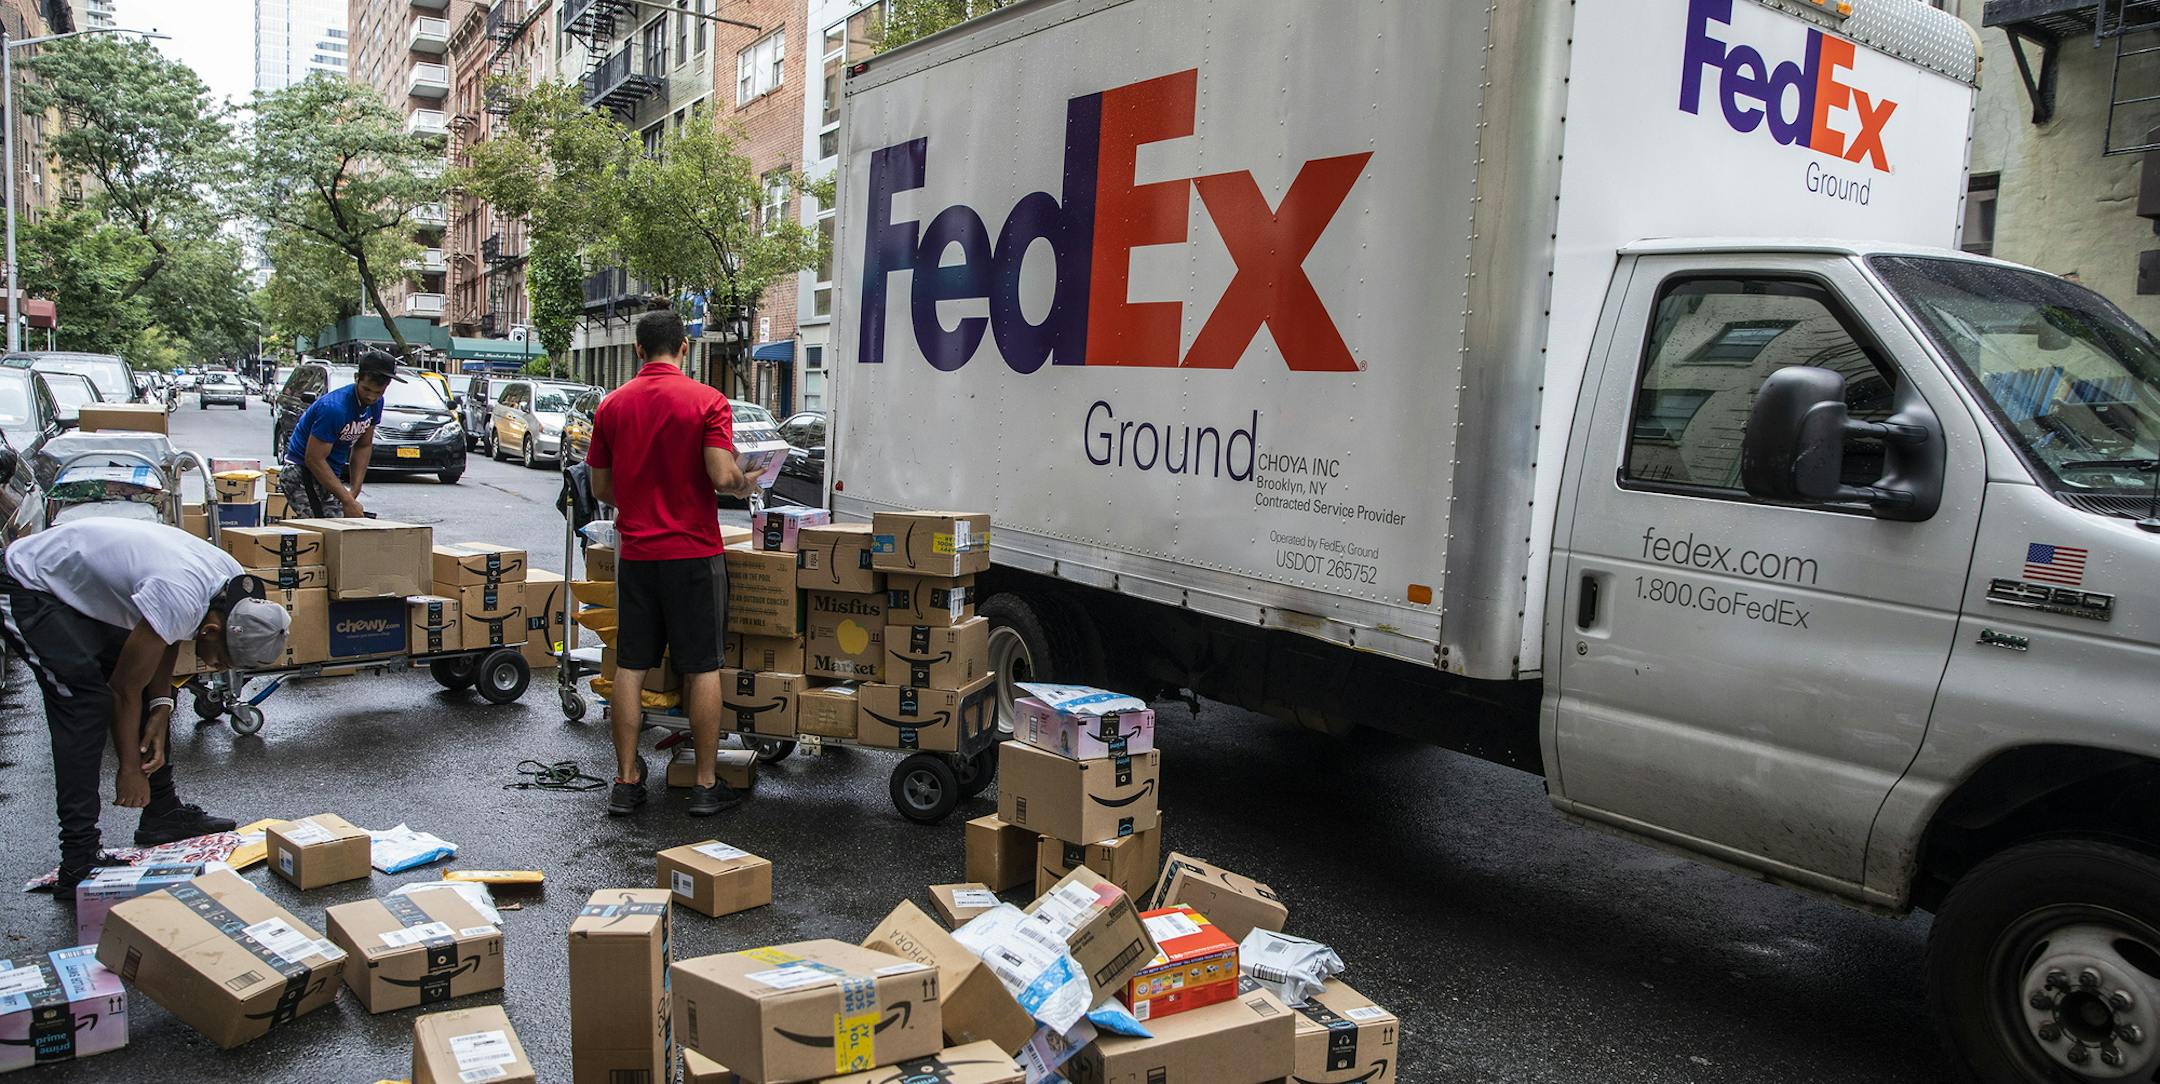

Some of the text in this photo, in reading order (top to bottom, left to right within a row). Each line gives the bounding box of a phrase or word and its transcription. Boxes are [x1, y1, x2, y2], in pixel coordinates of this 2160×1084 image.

[1679, 0, 1898, 173] FedEx
[1806, 161, 1871, 206] Ground
[858, 68, 1375, 374] FedEx
[1083, 400, 1259, 482] Ground
[1258, 453, 1340, 478] CHOYA INC
[1256, 475, 1327, 496] Brooklyn, NY
[1255, 492, 1406, 526] Contracted Service Provider
[1269, 529, 1379, 560] Operated by FedEx Ground
[1642, 526, 1818, 585] fedex.com
[1276, 549, 1377, 585] USDOT 265752
[814, 595, 881, 616] Misfits
[1635, 575, 1810, 630] 1.800.GoFedEx
[813, 654, 877, 676] Market
[864, 976, 876, 1007] YEA
[35, 1032, 67, 1046] prime
[39, 1042, 71, 1055] prime
